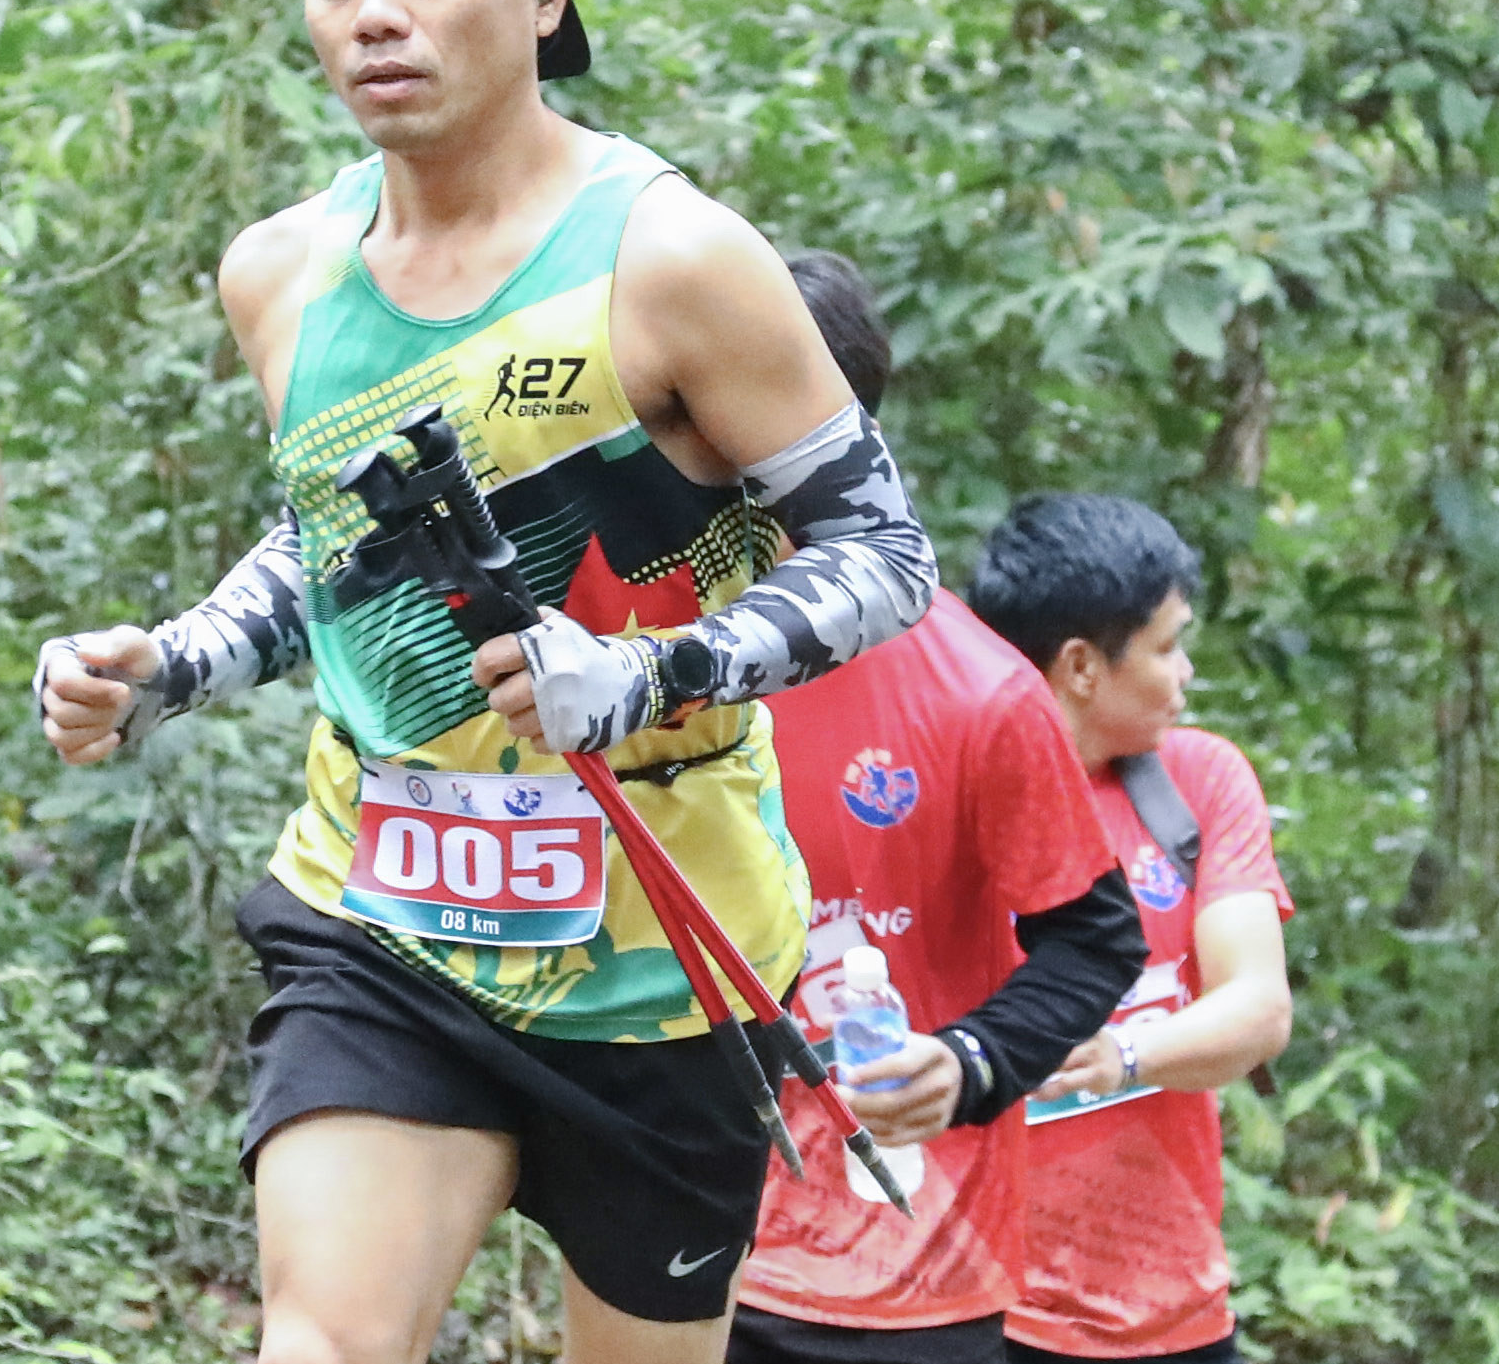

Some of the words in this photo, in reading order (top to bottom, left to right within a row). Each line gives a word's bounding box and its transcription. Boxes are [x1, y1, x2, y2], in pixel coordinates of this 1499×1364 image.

[519, 357, 587, 399] 27
[518, 401, 552, 419] ĐIỆN
[555, 400, 589, 416] BIÊN
[372, 816, 586, 902] 005
[440, 909, 466, 931] 08
[472, 913, 500, 936] km
